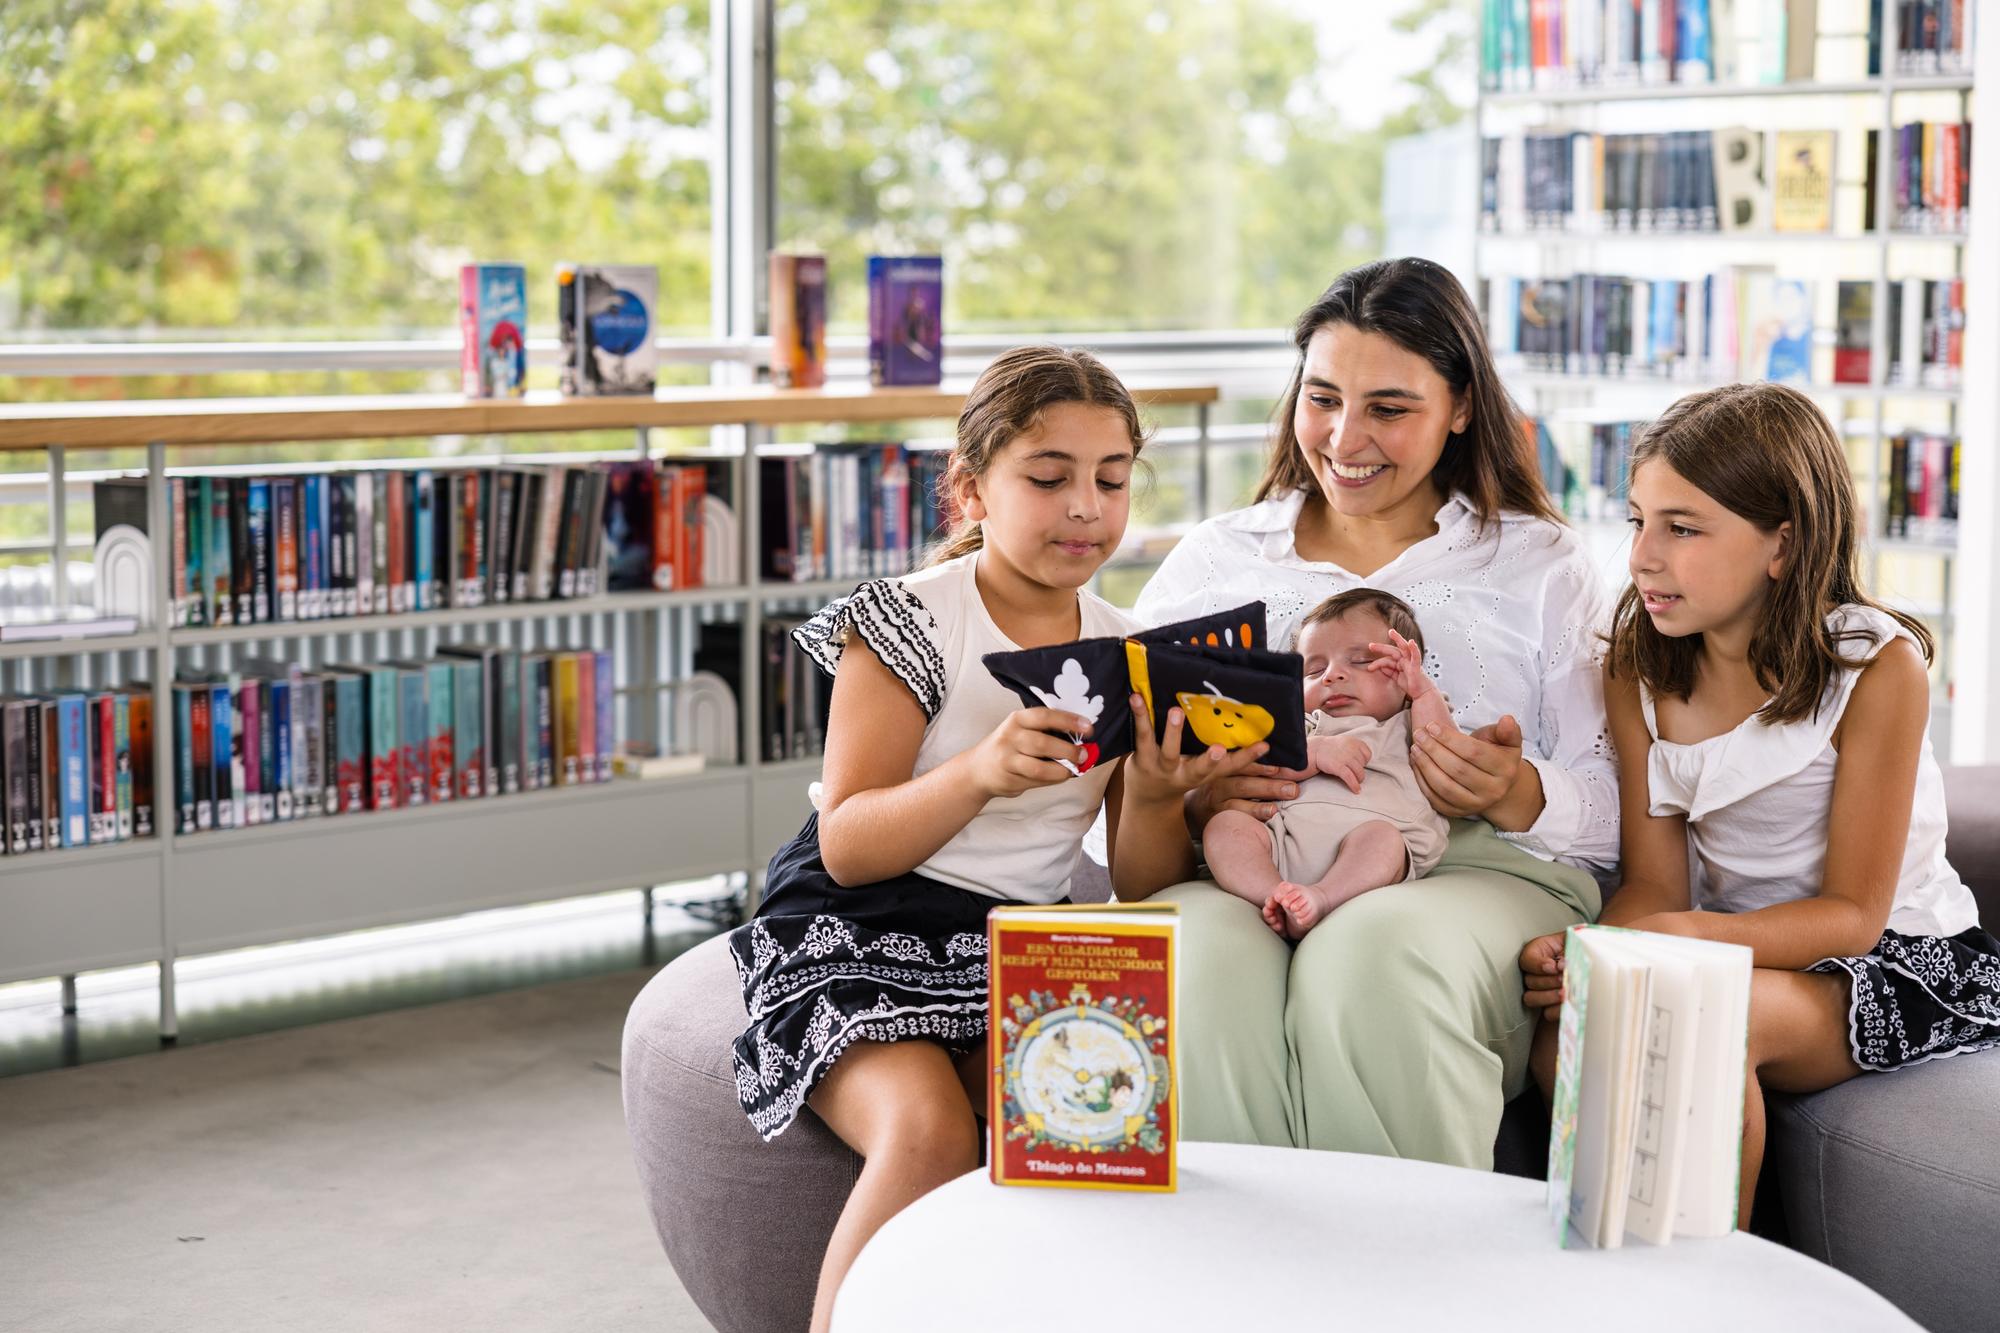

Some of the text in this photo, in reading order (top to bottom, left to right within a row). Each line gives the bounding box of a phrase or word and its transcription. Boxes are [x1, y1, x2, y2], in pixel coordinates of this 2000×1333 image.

[1026, 943, 1138, 959] EEN GLADIATOR
[1001, 955, 1048, 967] HEEFT
[1088, 958, 1165, 972] LUNCHBOX
[1046, 968, 1120, 982] GESTOLEN
[1026, 1160, 1146, 1177] Thiago de Moraes
